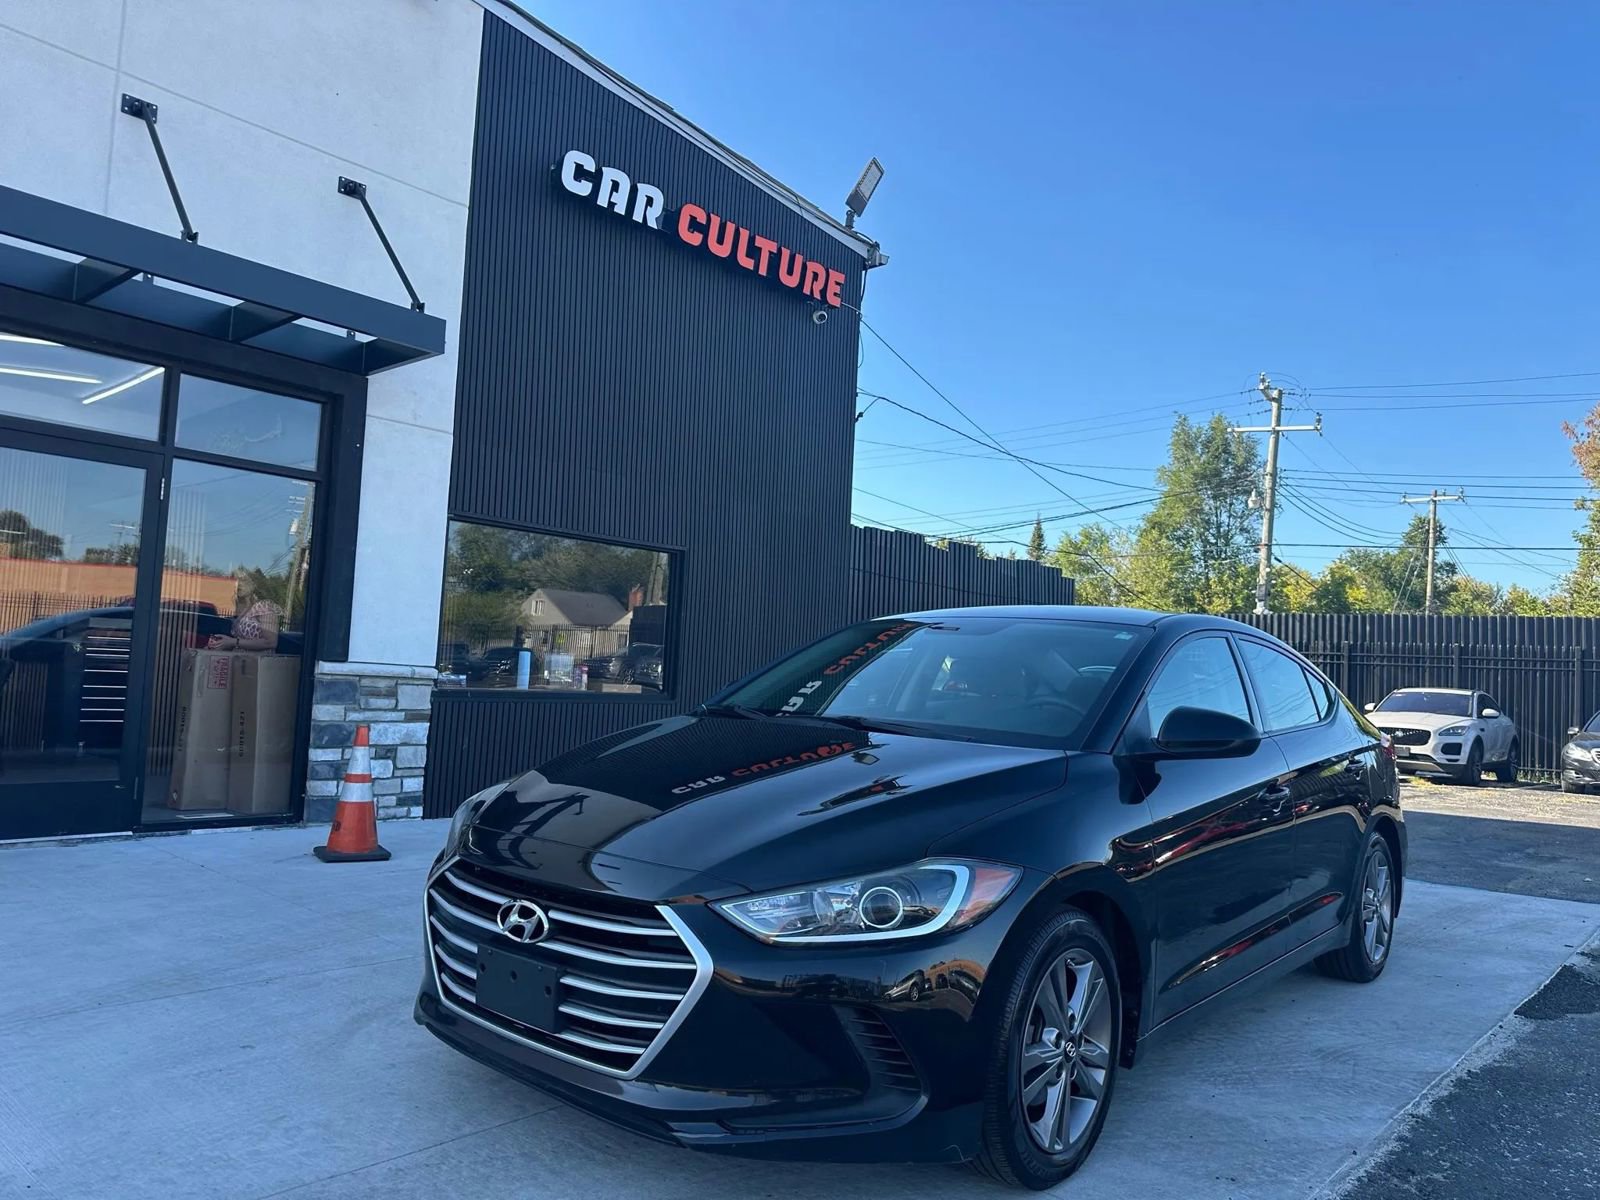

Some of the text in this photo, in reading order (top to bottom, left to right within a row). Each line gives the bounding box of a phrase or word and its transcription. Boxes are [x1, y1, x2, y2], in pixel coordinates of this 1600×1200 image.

[561, 150, 846, 308] CAR CULTURE
[219, 657, 229, 689] FRAGILE
